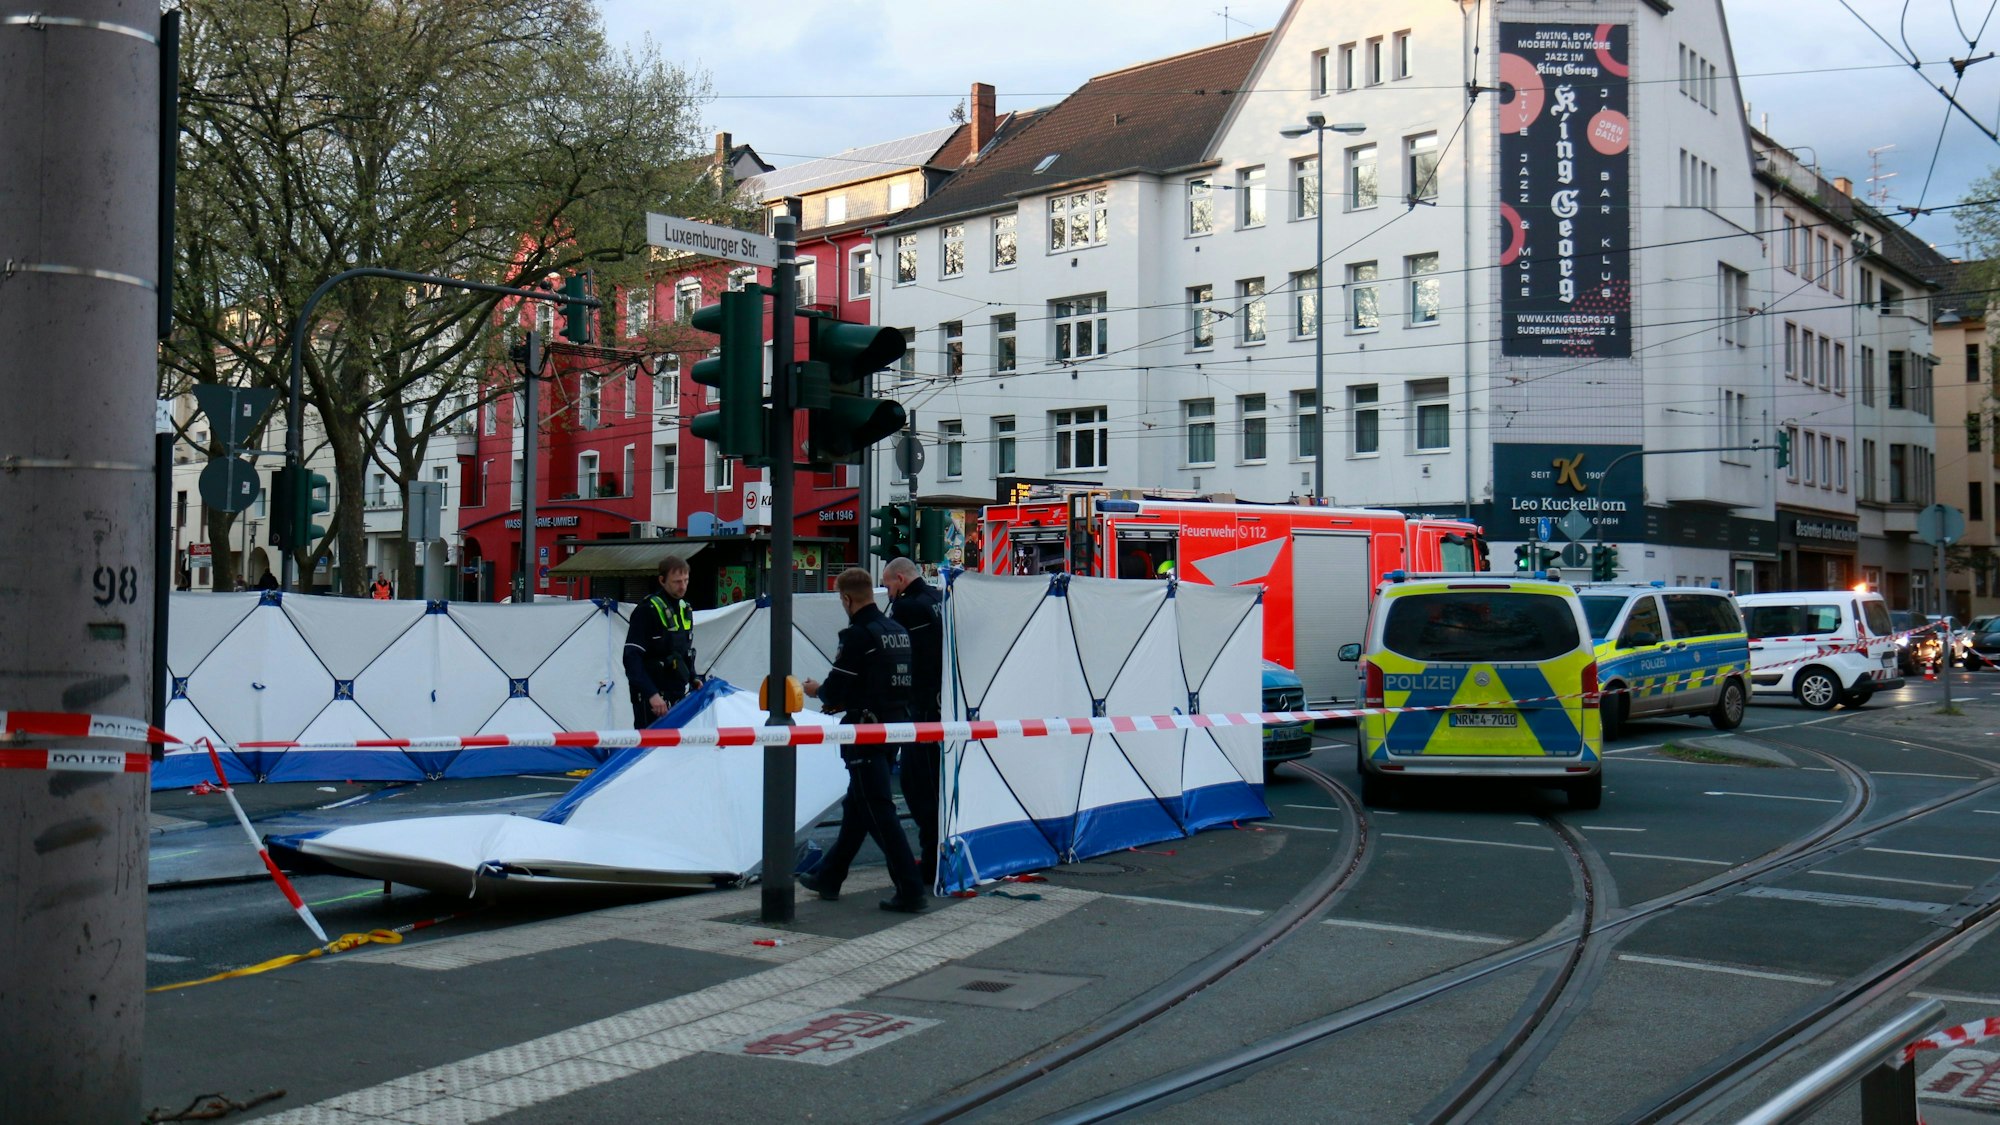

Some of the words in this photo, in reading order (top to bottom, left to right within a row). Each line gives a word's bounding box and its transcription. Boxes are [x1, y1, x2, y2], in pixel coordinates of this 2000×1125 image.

[1518, 40, 1559, 49] MODERN
[1561, 41, 1581, 50] AND
[1583, 41, 1611, 50] MORE
[1535, 32, 1571, 42] SWING,
[1573, 32, 1594, 42] BOP,
[1545, 53, 1568, 62] JAZZ
[1571, 53, 1584, 62] IM
[1535, 62, 1563, 77] King
[1563, 63, 1598, 78] Georg
[1519, 87, 1529, 137] LIVE
[1550, 84, 1578, 184] King
[1599, 120, 1624, 135] OPEN
[1594, 128, 1622, 144] DAILY
[1519, 153, 1529, 203] JAZZ
[1600, 172, 1610, 214] BAR
[664, 222, 738, 257] Luxemburger
[741, 238, 759, 258] Str.
[1550, 189, 1579, 303] Georg
[1518, 247, 1531, 297] MORE
[1601, 238, 1611, 298] KLUB
[1517, 314, 1616, 324] WWW.KINGGEORG.DE
[1531, 471, 1551, 479] SEIT
[1511, 497, 1538, 511] Leo
[1541, 496, 1627, 512] Kuckelkorn
[819, 510, 834, 521] Seit
[836, 510, 854, 520] 1946
[1181, 524, 1236, 538] Feuerwehr
[1249, 526, 1267, 539] 112
[93, 566, 137, 608] 98
[1641, 656, 1667, 671] POLIZEI
[1385, 675, 1456, 690] POLIZEI
[1456, 713, 1475, 726] NRW
[1480, 713, 1516, 726] 4-7010
